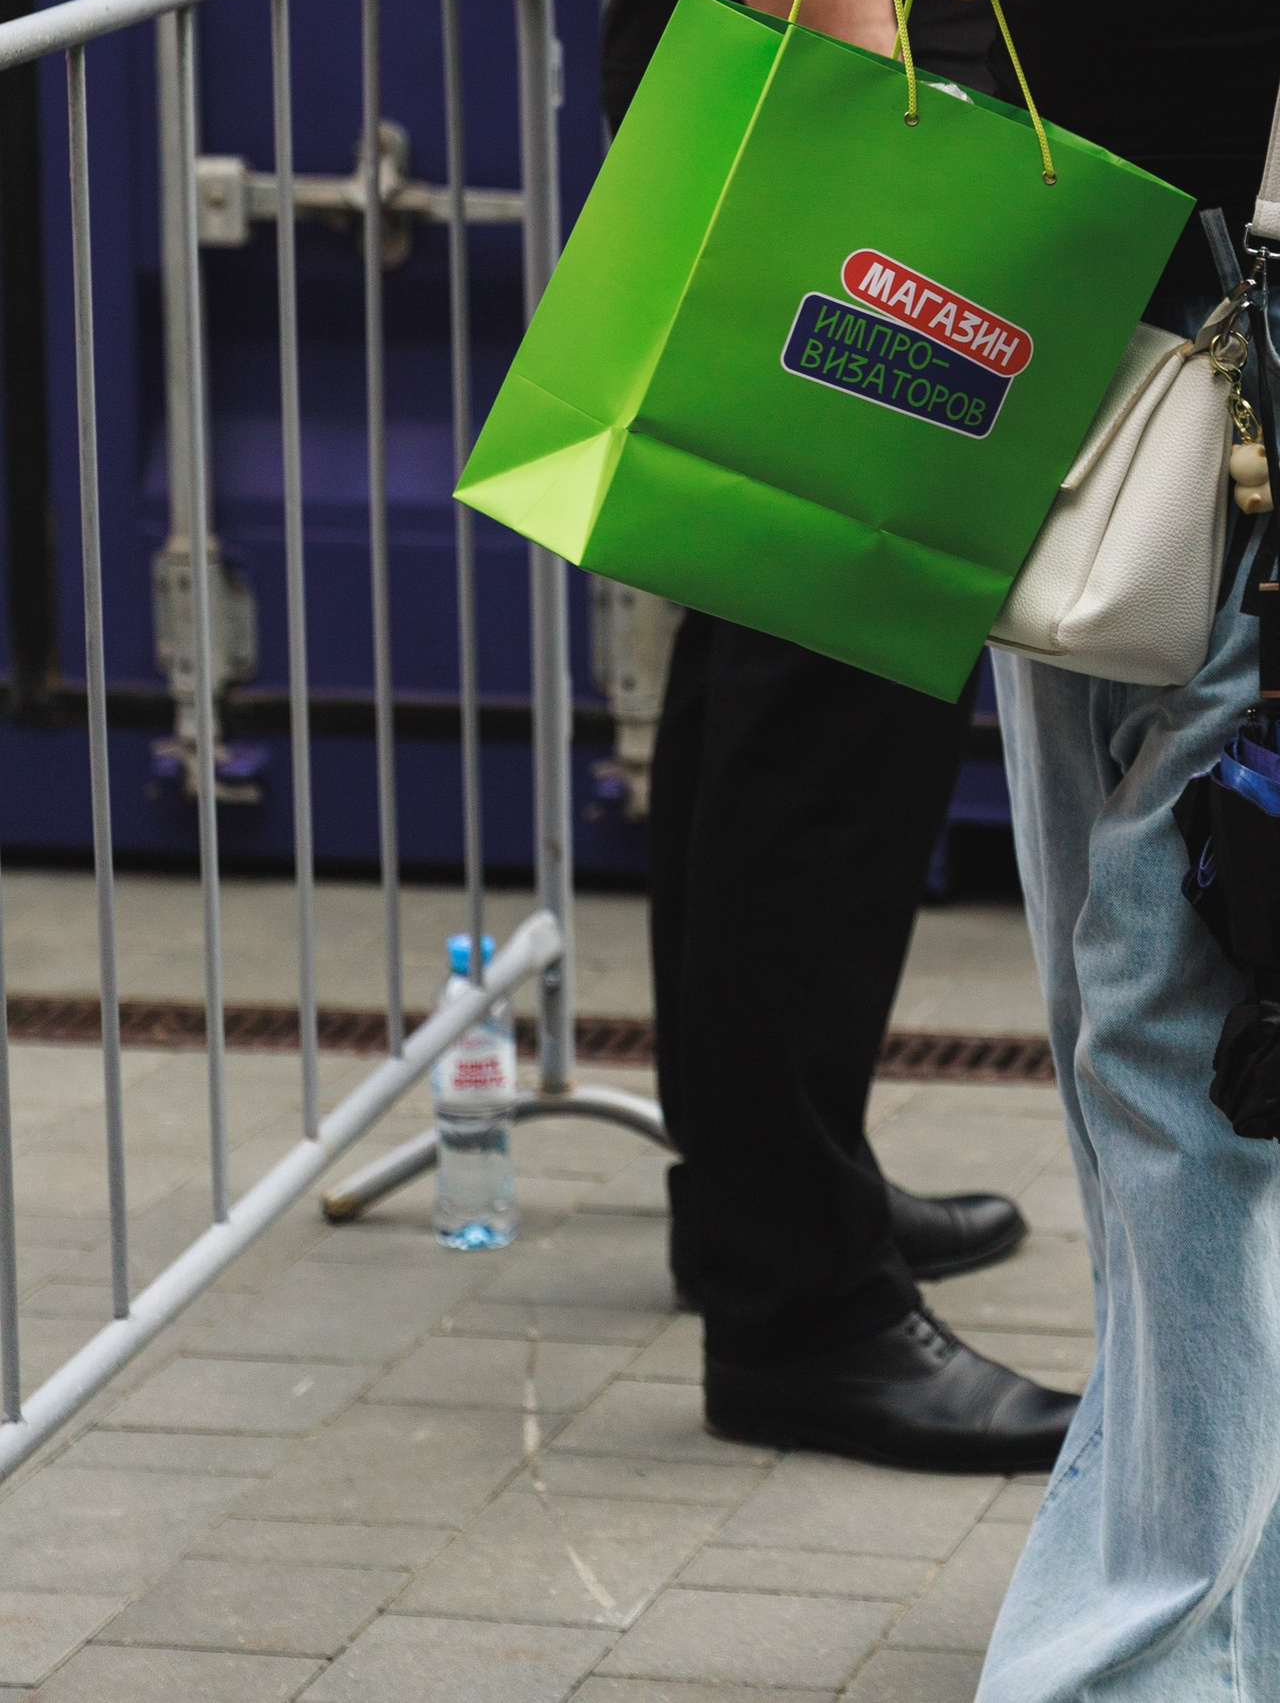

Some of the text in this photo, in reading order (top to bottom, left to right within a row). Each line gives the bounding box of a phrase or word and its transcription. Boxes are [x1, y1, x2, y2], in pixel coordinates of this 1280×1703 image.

[813, 305, 951, 370] ИМПРО-
[857, 261, 1020, 368] МАГАЗИН
[800, 338, 988, 427] ВИЗАТОРОВ
